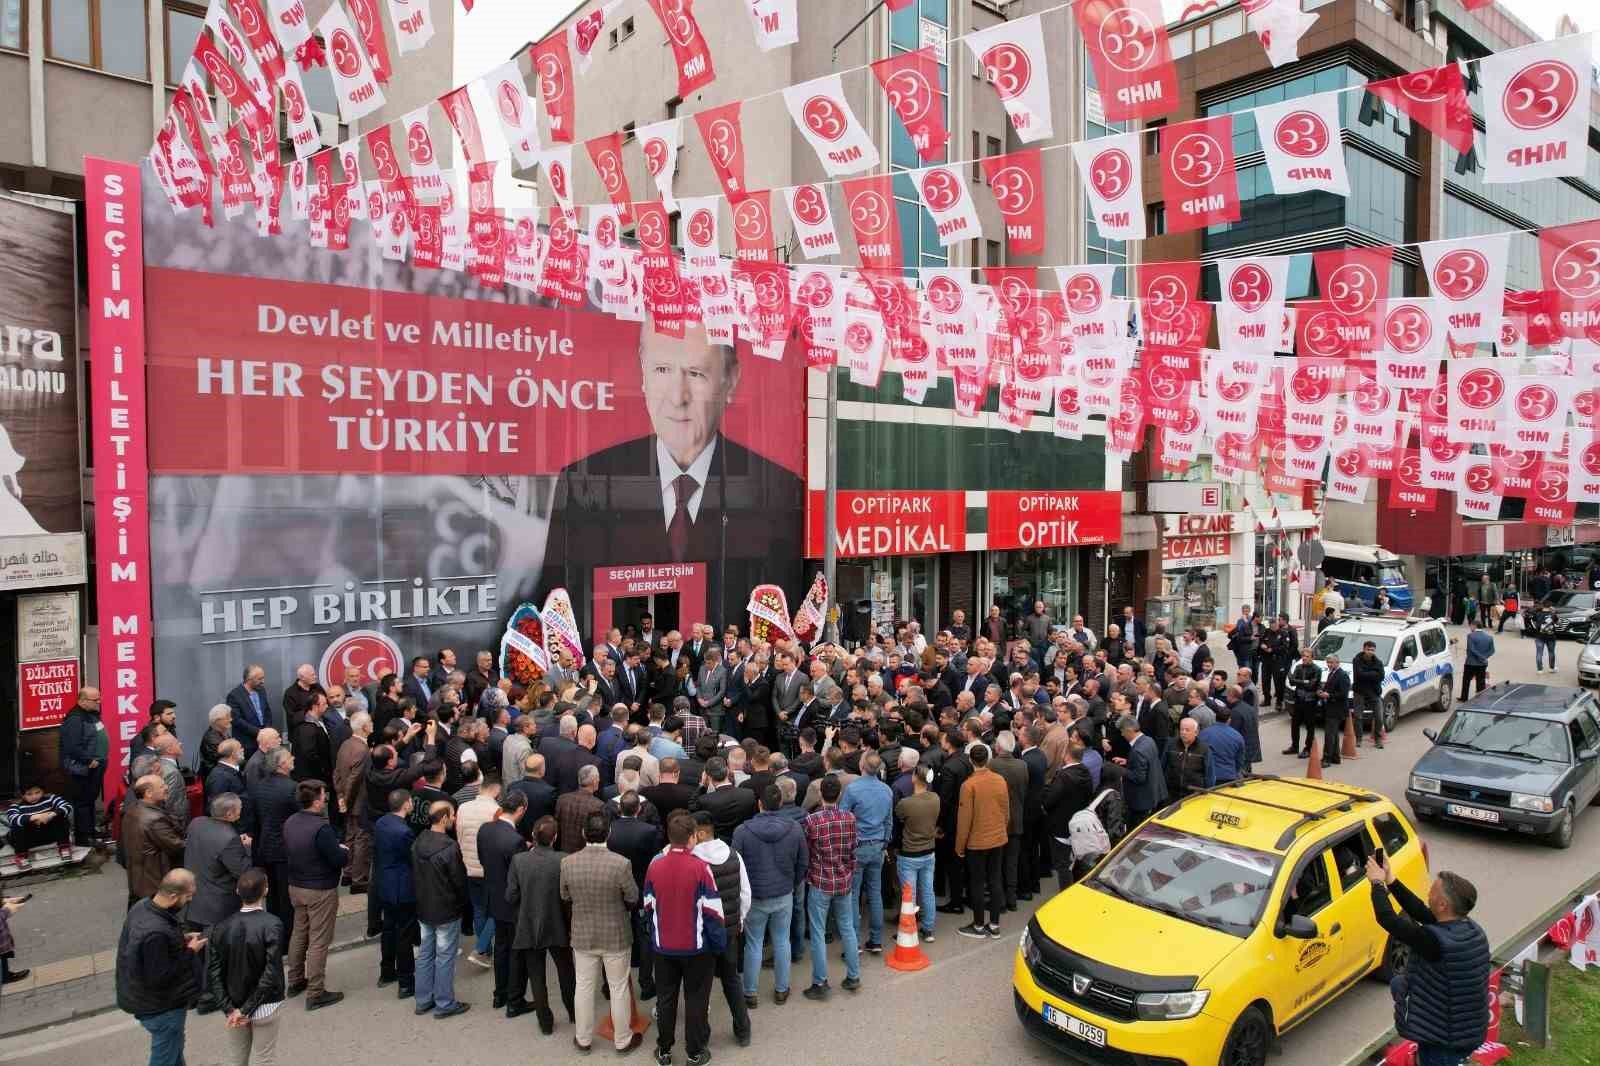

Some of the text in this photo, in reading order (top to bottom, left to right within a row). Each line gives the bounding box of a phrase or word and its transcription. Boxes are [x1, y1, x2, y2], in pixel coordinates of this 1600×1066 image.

[103, 173, 131, 320] SEÇİM
[0, 325, 64, 362] ra
[258, 304, 575, 361] Devlet ve Milletiyle
[197, 357, 616, 412] HER ŞEYDEN ÖNCE
[329, 408, 520, 454] TÜRKİYE
[851, 492, 932, 514] OPTİPARK
[1019, 493, 1080, 512] OPTİPARK
[1205, 491, 1216, 504] E
[836, 518, 950, 555] MEDİKAL
[1018, 515, 1079, 546] OPTİK
[1179, 514, 1235, 534] ECZANE
[609, 567, 645, 580] SEÇİM
[628, 576, 677, 592] MERKEZİ
[201, 577, 497, 634] HEP BİRLİKTE
[112, 614, 138, 767] MERKEZ
[1049, 1007, 1103, 1042] 16 T 0259
